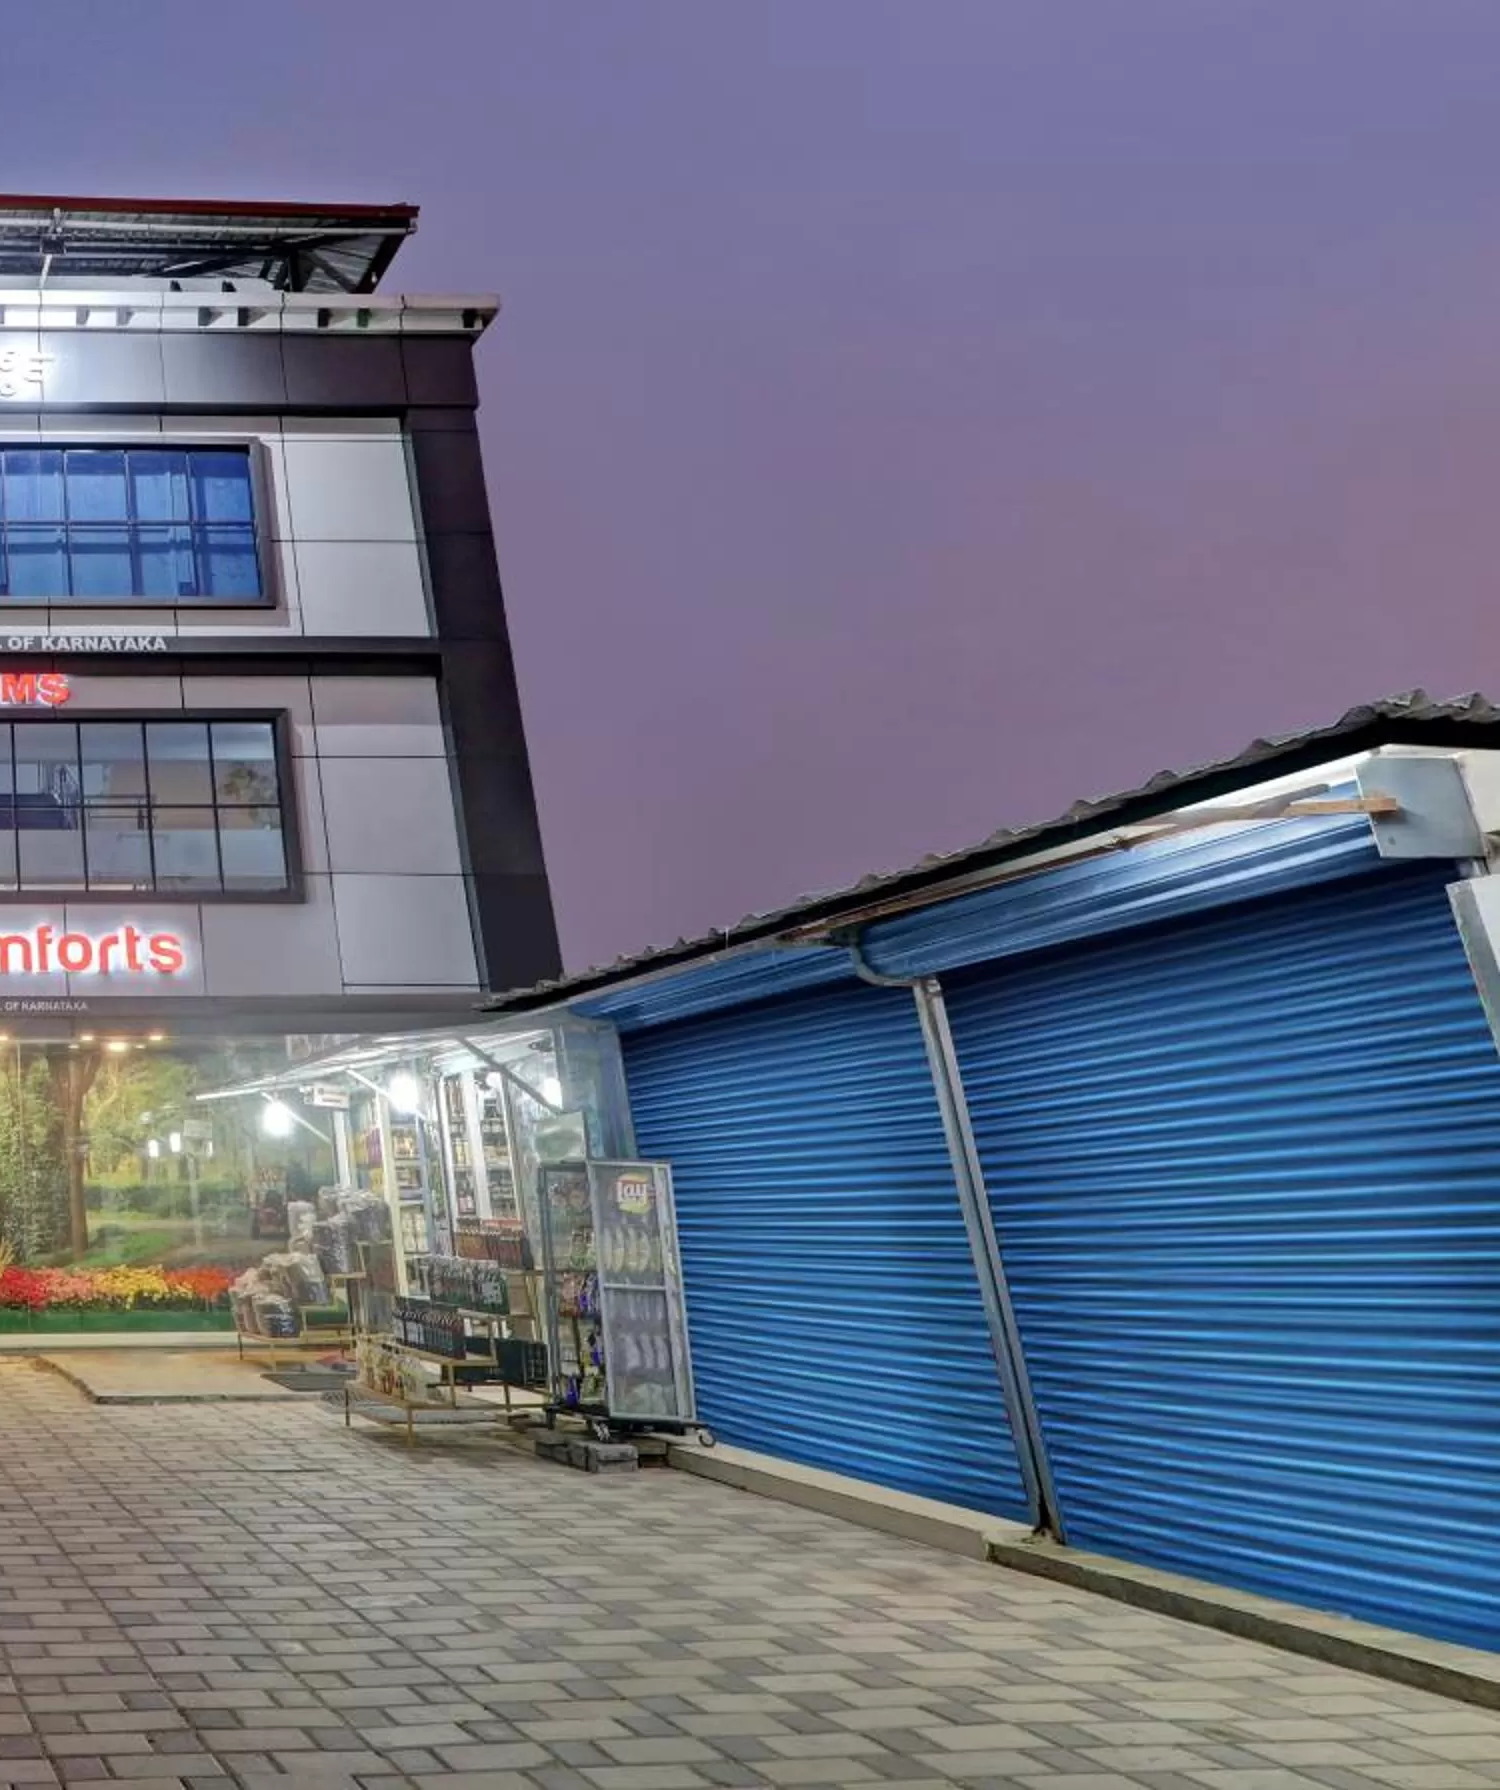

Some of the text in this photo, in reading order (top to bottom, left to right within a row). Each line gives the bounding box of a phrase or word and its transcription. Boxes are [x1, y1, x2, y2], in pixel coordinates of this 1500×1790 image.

[7, 634, 35, 651] OF
[41, 634, 167, 651] KARNATAKA
[21, 1001, 88, 1012] KARNATAKA
